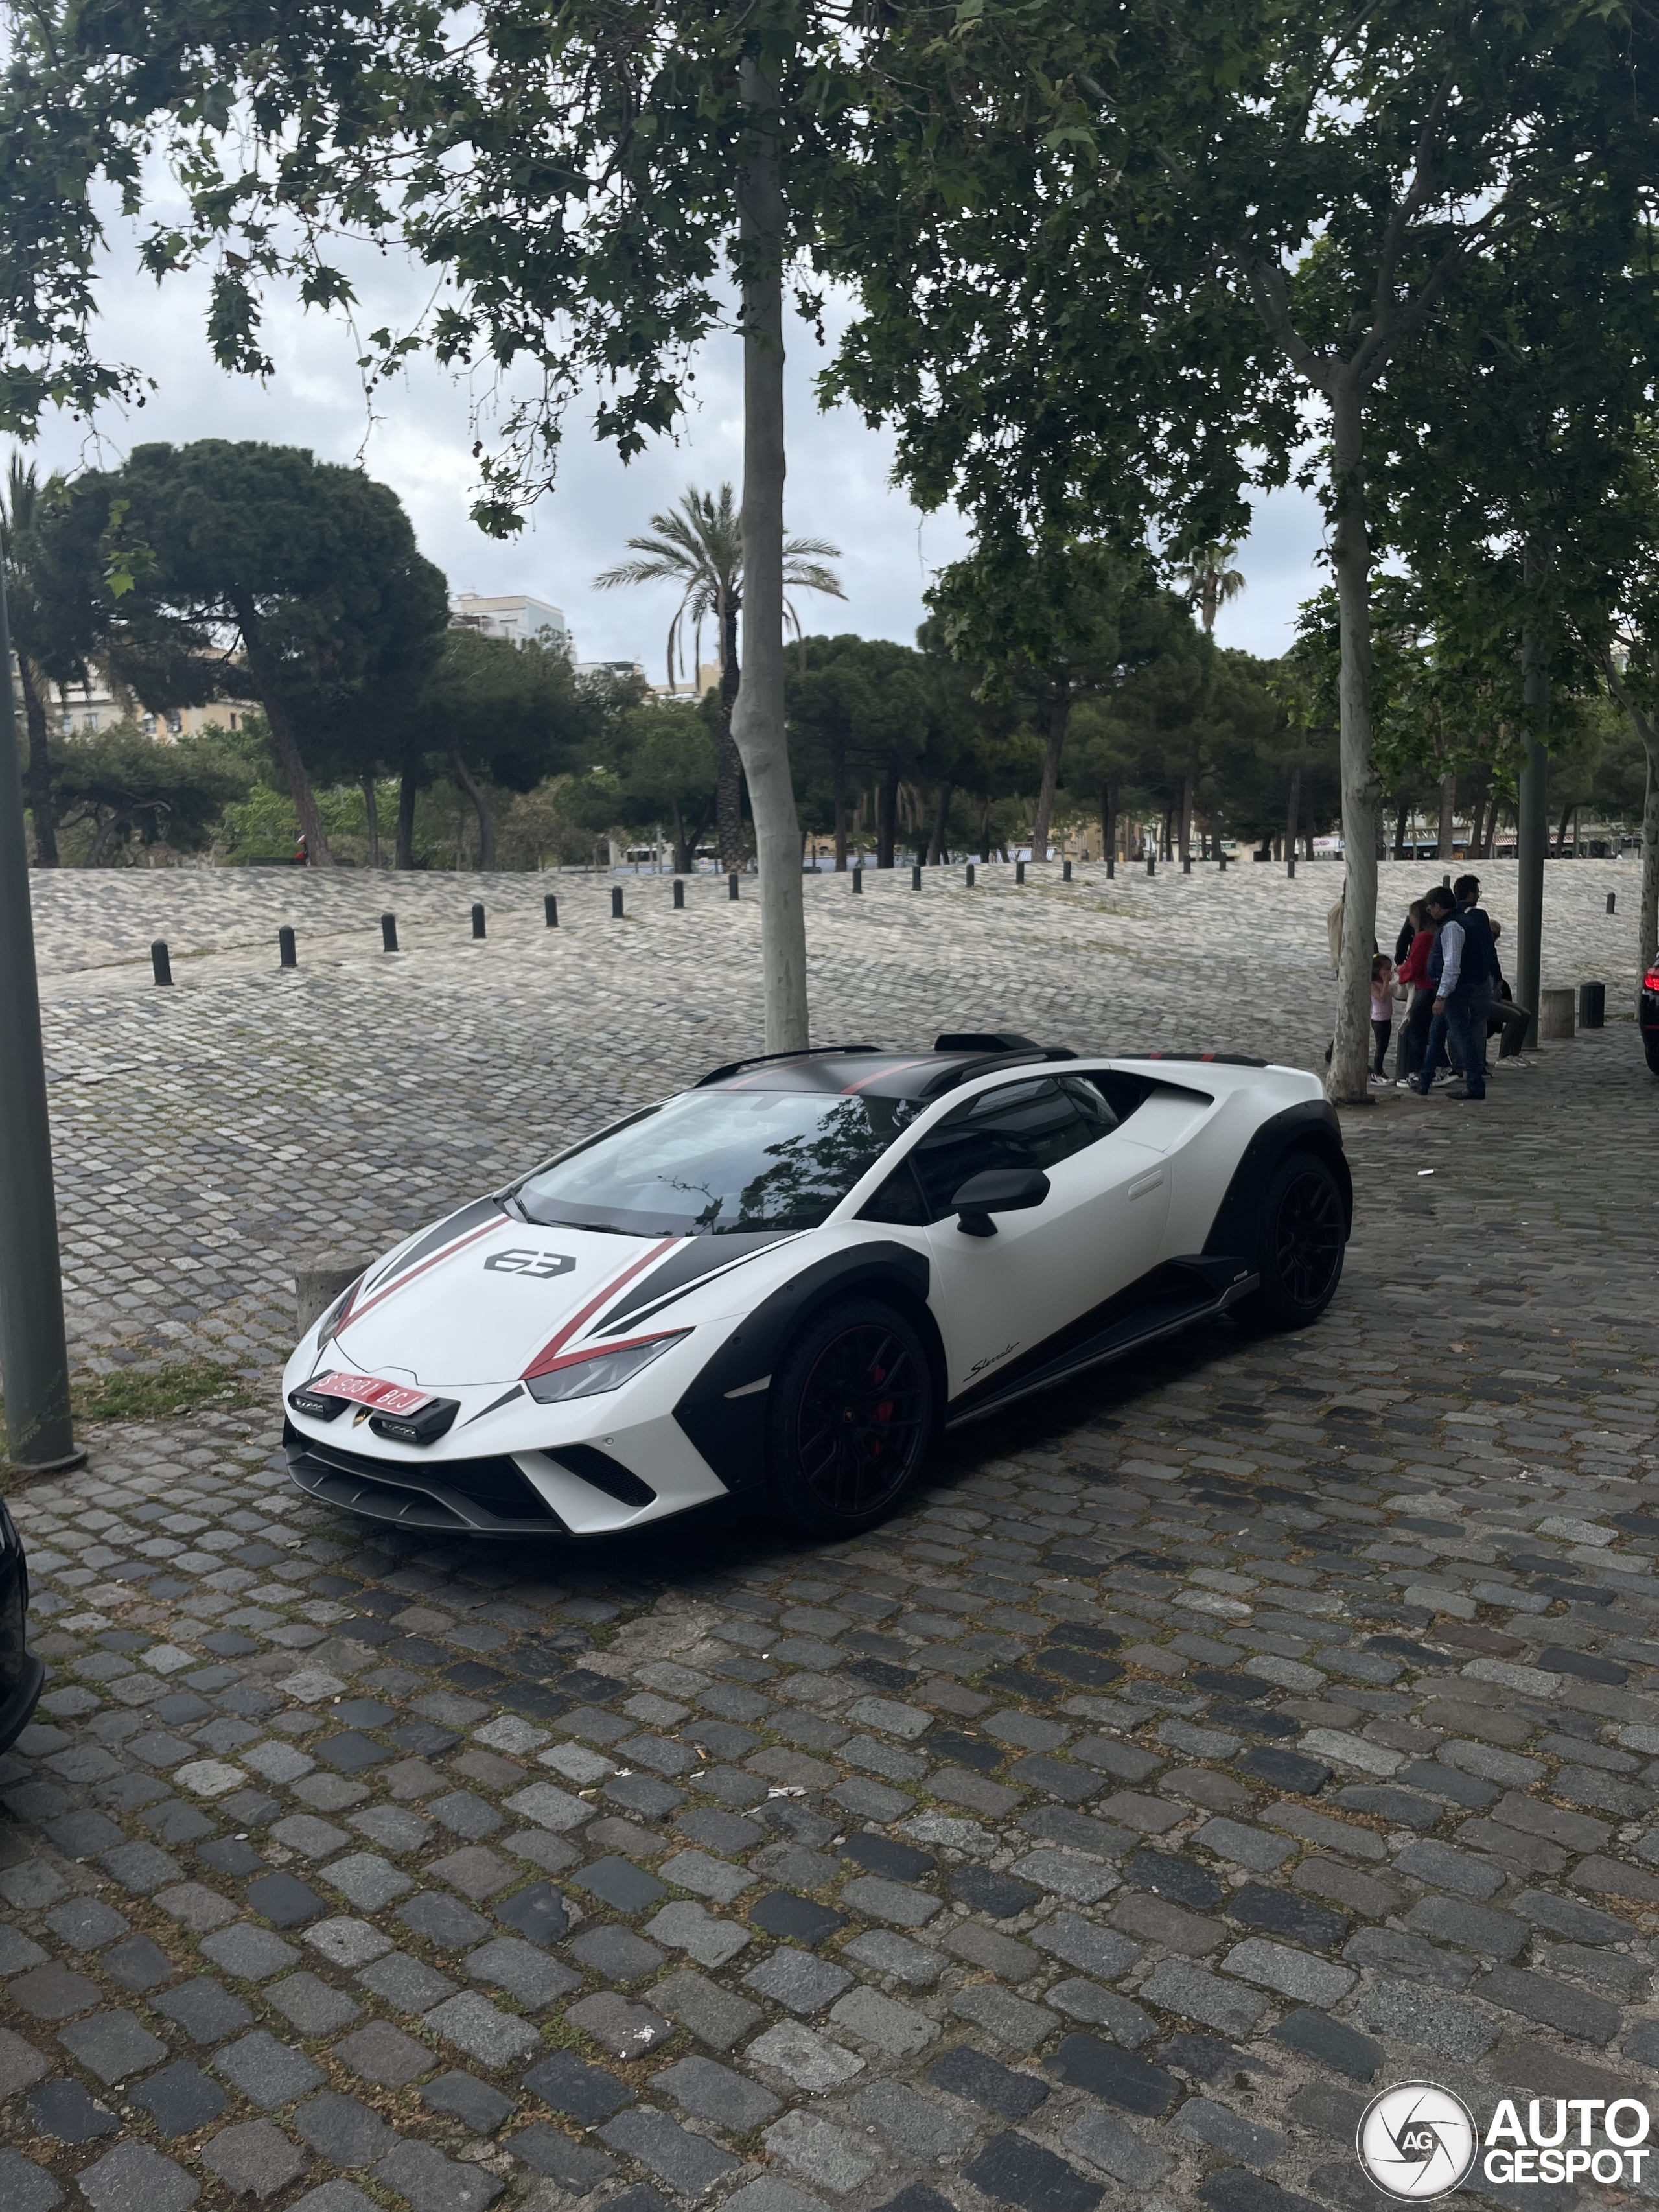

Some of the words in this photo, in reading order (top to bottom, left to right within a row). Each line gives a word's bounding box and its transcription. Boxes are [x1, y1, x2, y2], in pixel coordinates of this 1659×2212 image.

[483, 1248, 577, 1279] 63
[318, 1375, 338, 1387] S
[376, 1389, 419, 1408] BCJ
